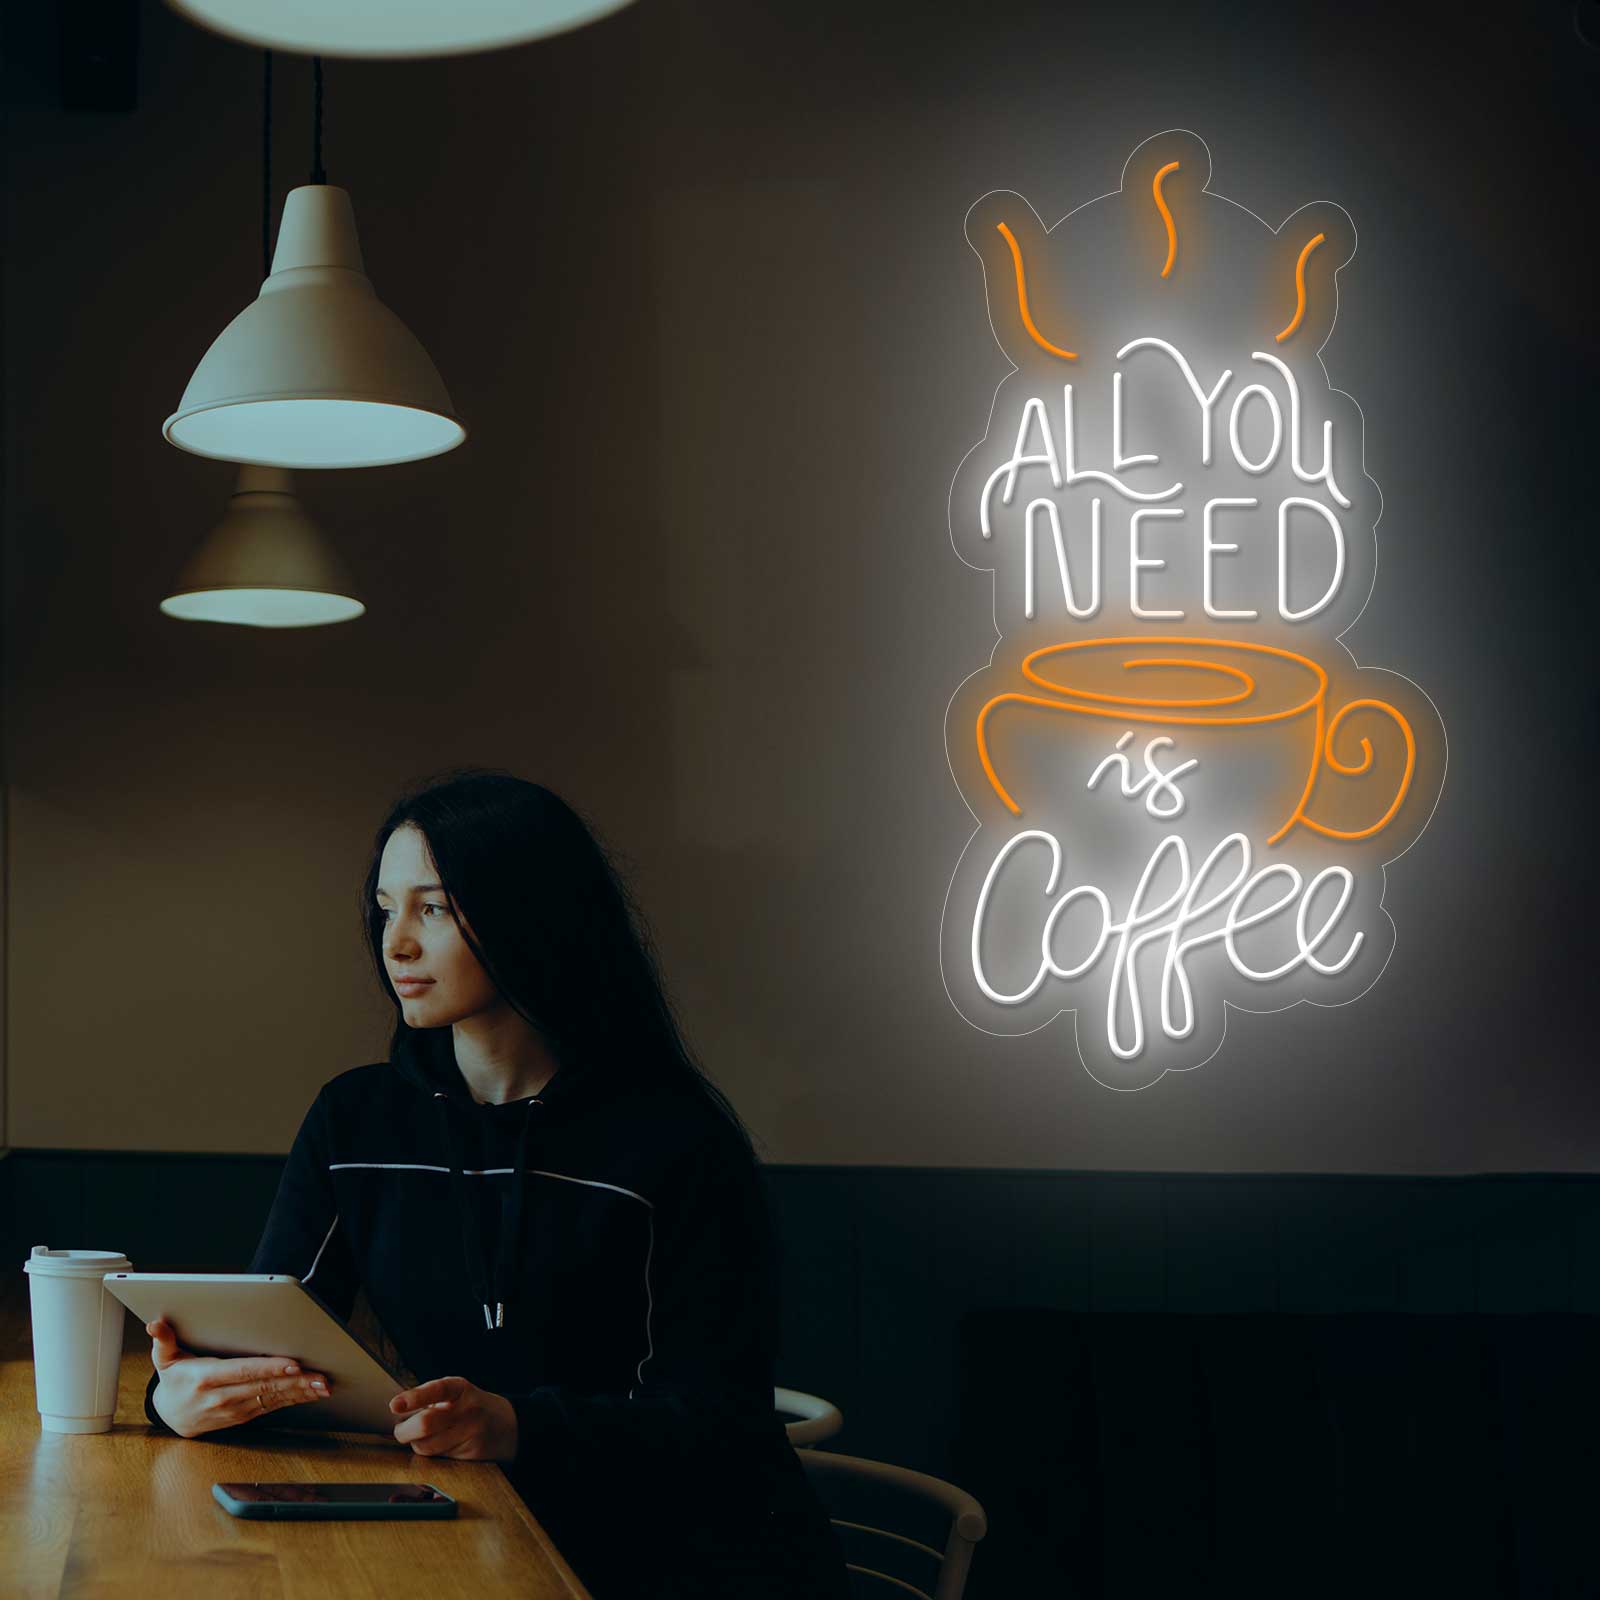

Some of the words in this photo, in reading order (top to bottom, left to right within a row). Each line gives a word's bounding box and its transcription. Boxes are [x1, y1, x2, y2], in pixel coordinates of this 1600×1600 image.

[980, 373, 1184, 538] ALL
[1116, 337, 1351, 508] YOU
[1025, 497, 1345, 621] NEED
[1087, 731, 1198, 817] is
[971, 830, 1364, 1059] Coffee
